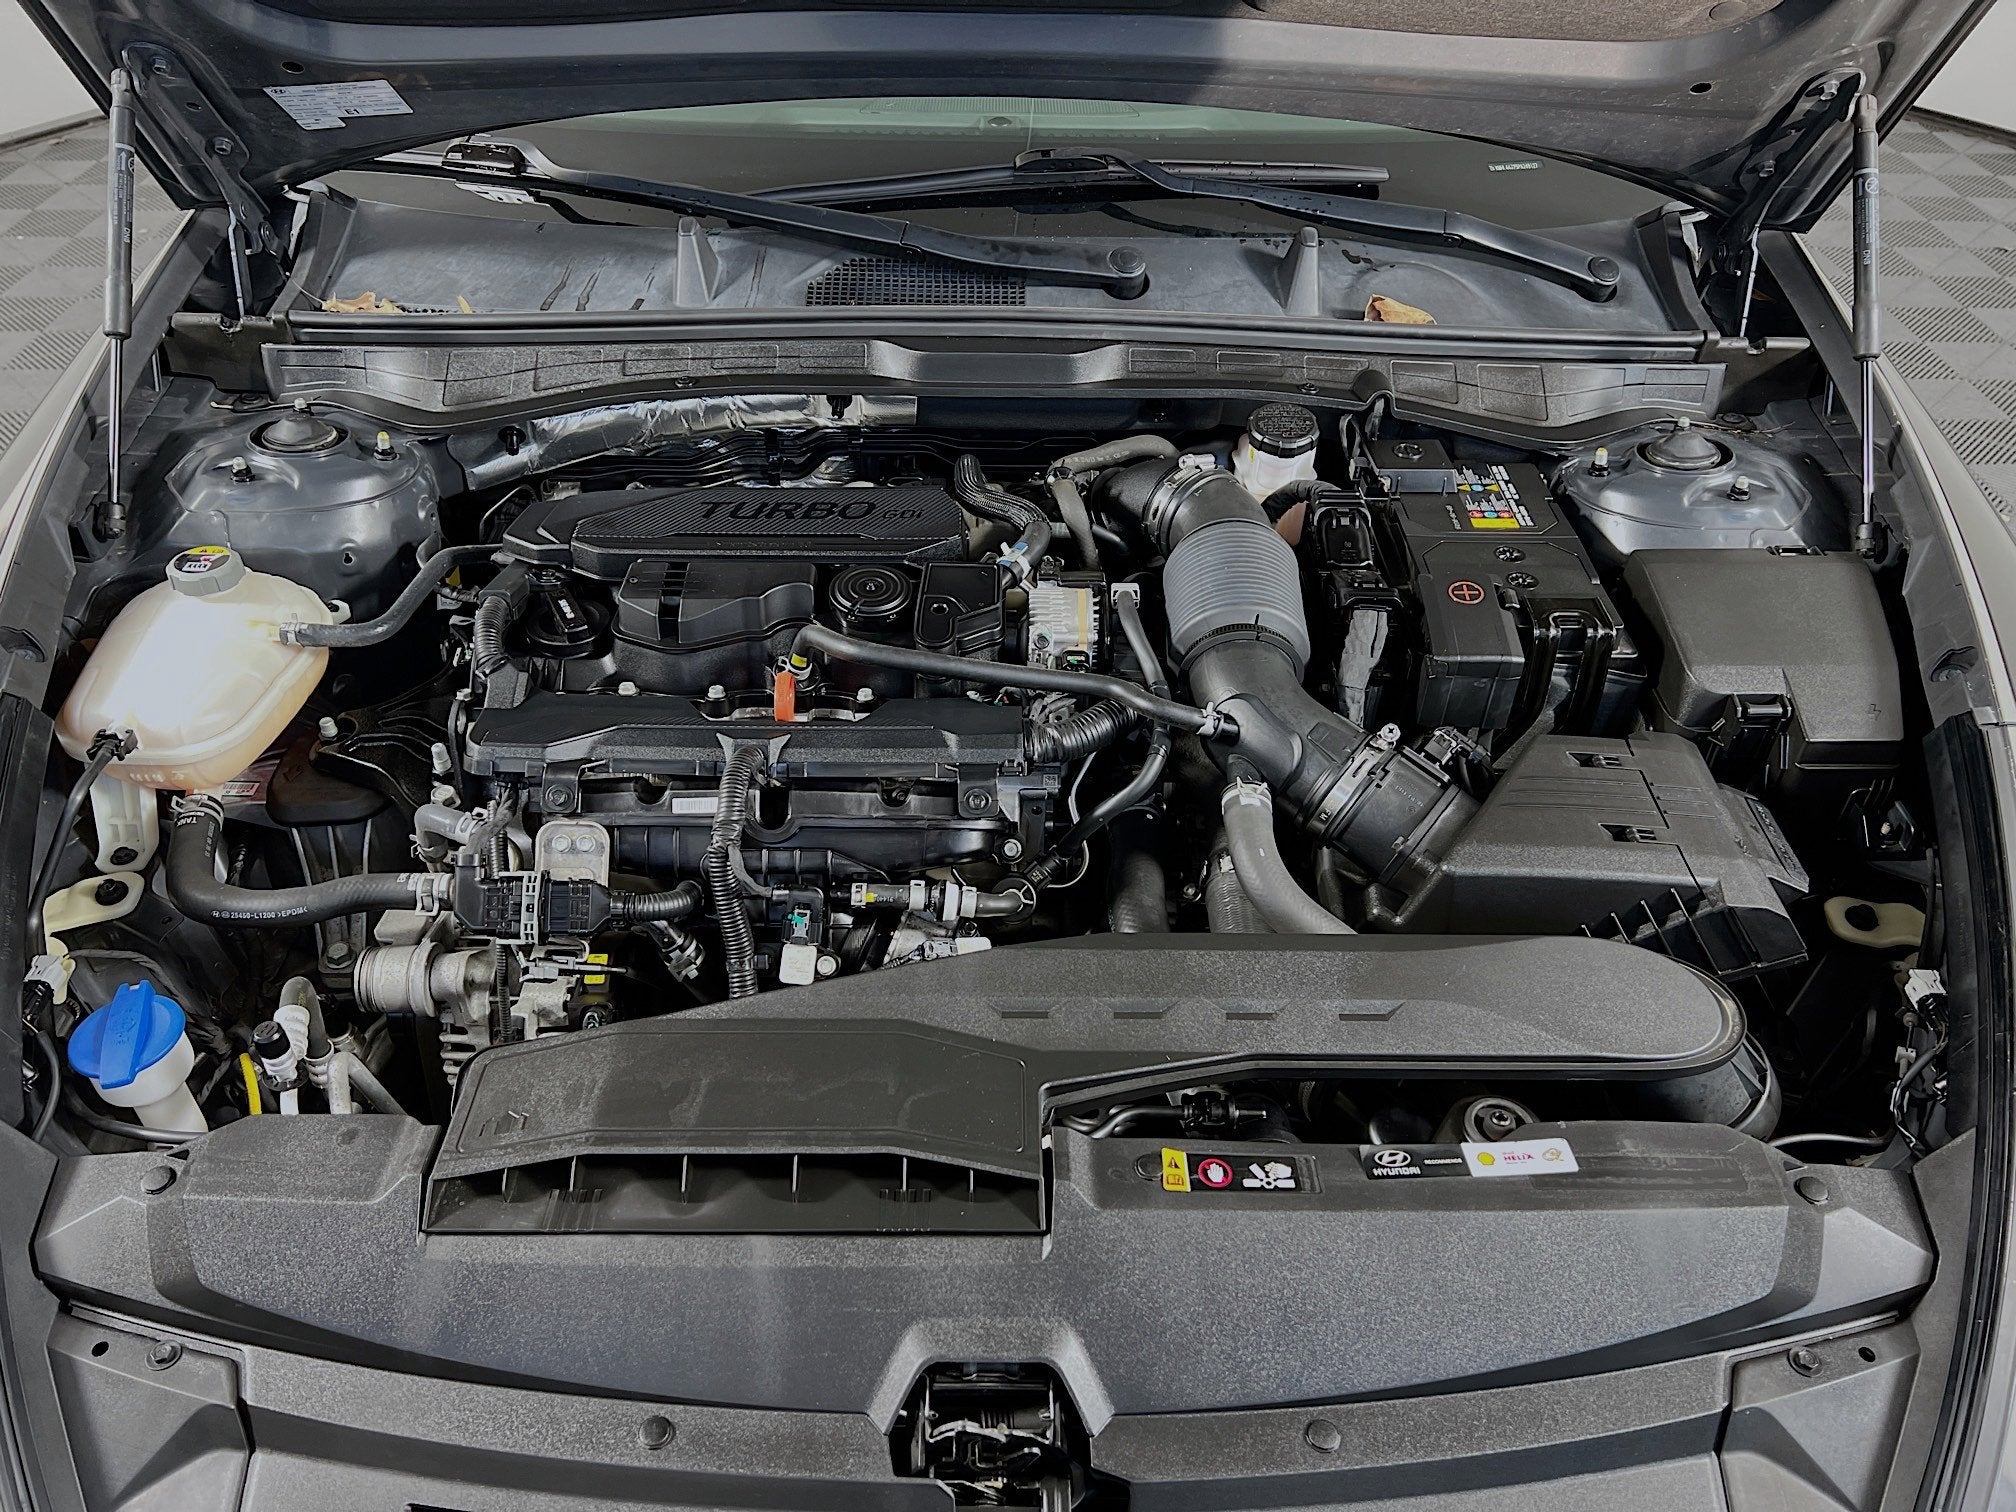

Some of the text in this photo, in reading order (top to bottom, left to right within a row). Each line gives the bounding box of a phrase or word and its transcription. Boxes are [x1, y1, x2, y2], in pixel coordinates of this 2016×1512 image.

[700, 500, 877, 520] TURBO
[230, 911, 277, 919] 25450-L1200
[1503, 1153, 1534, 1161] HELIX
[1373, 1166, 1421, 1176] HYUNDAI
